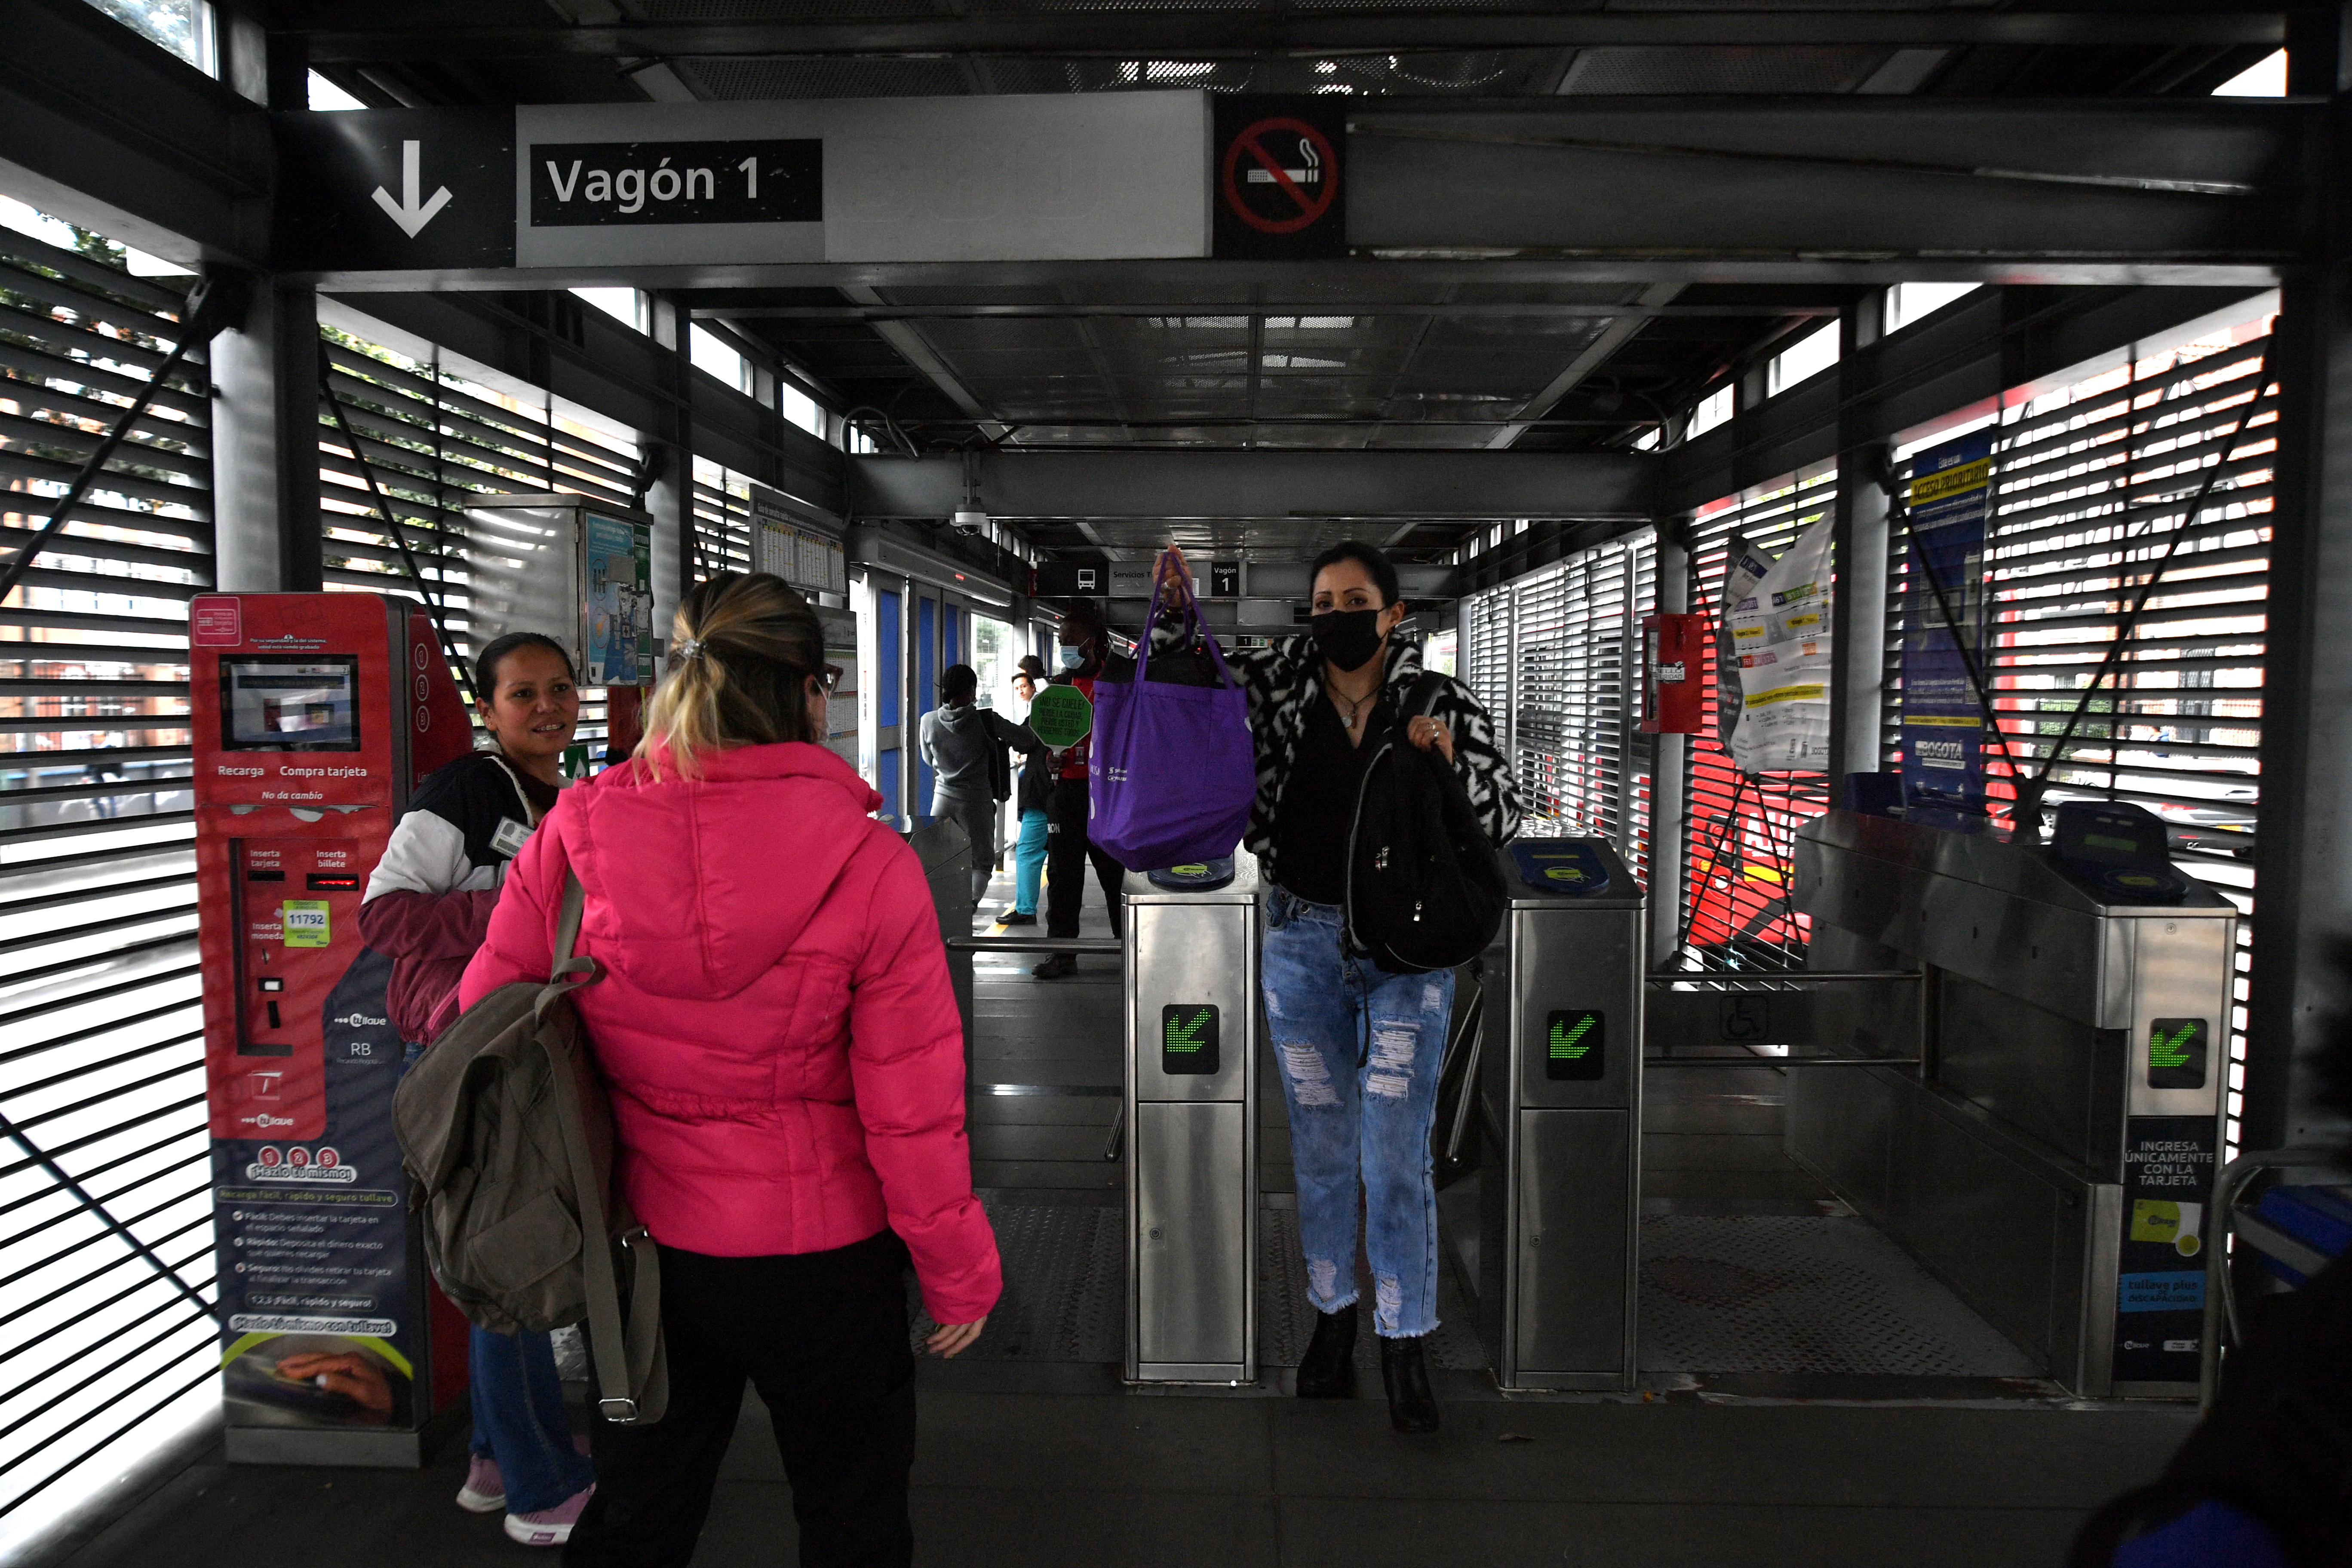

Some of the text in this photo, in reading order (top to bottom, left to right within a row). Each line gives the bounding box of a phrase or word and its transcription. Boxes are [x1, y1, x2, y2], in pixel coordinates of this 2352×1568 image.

[545, 156, 757, 213] Vagón 1
[1938, 457, 1947, 469] Este
[1941, 463, 1988, 491] PRIORITARIO
[1213, 567, 1237, 575] Vagón
[1221, 577, 1229, 592] 1
[1052, 697, 1061, 708] SE
[218, 765, 264, 777] Recarga
[279, 766, 367, 778] Compra tarjeta
[261, 791, 323, 800] No da cambio
[251, 859, 280, 868] tarjeta
[317, 859, 346, 868] billete
[289, 914, 324, 924] 11792
[350, 1013, 387, 1028] tullave
[350, 1042, 372, 1056] RB
[2140, 1141, 2199, 1151] INGRESA
[294, 1152, 304, 1164] 2
[323, 1153, 333, 1165] 3
[2125, 1149, 2214, 1163] ÚNICAMENTE
[2143, 1163, 2193, 1174] CON LA
[2138, 1175, 2197, 1186] TARJETA
[219, 1191, 258, 1200] Recarga
[285, 1191, 315, 1202] rápido
[325, 1194, 357, 1203] seguro
[359, 1193, 392, 1202] tullave
[2128, 1279, 2198, 1292] tullave plus
